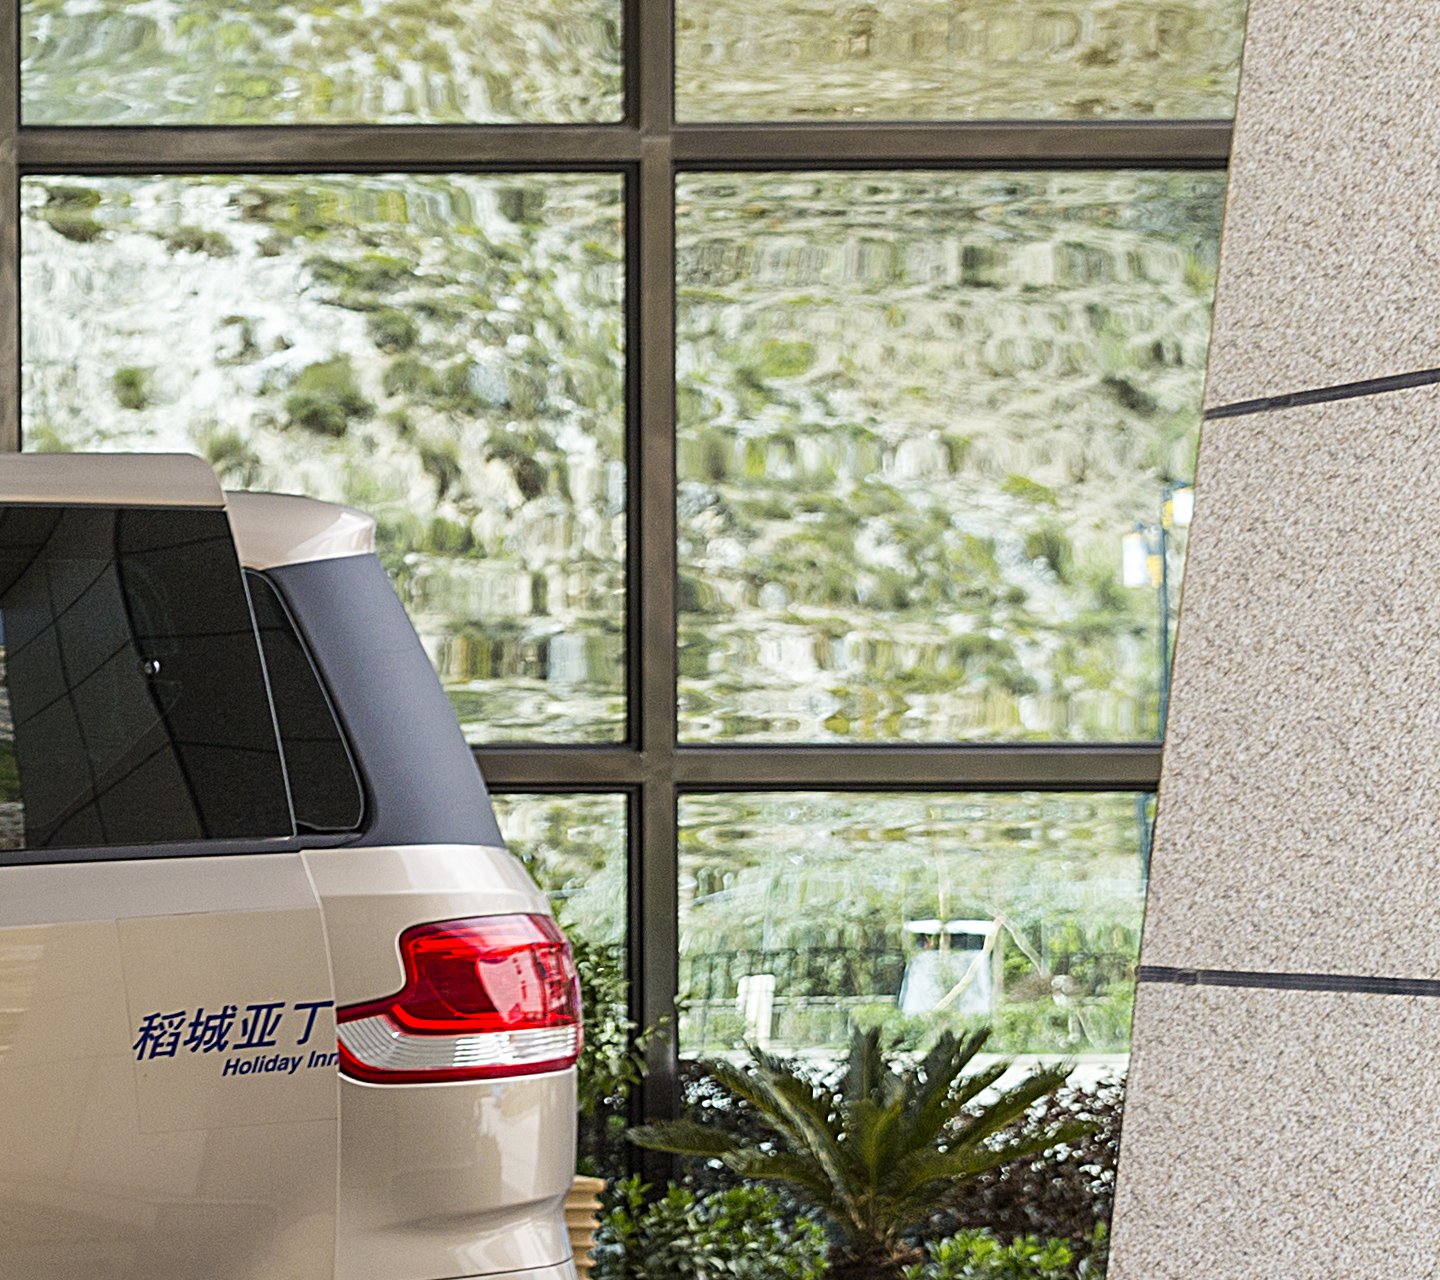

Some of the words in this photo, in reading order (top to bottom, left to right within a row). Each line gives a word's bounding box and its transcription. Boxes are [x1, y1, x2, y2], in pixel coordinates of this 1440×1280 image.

[133, 1001, 335, 1061] 稻城亚丁
[222, 1053, 303, 1076] Holiday
[307, 1050, 339, 1068] Inn
